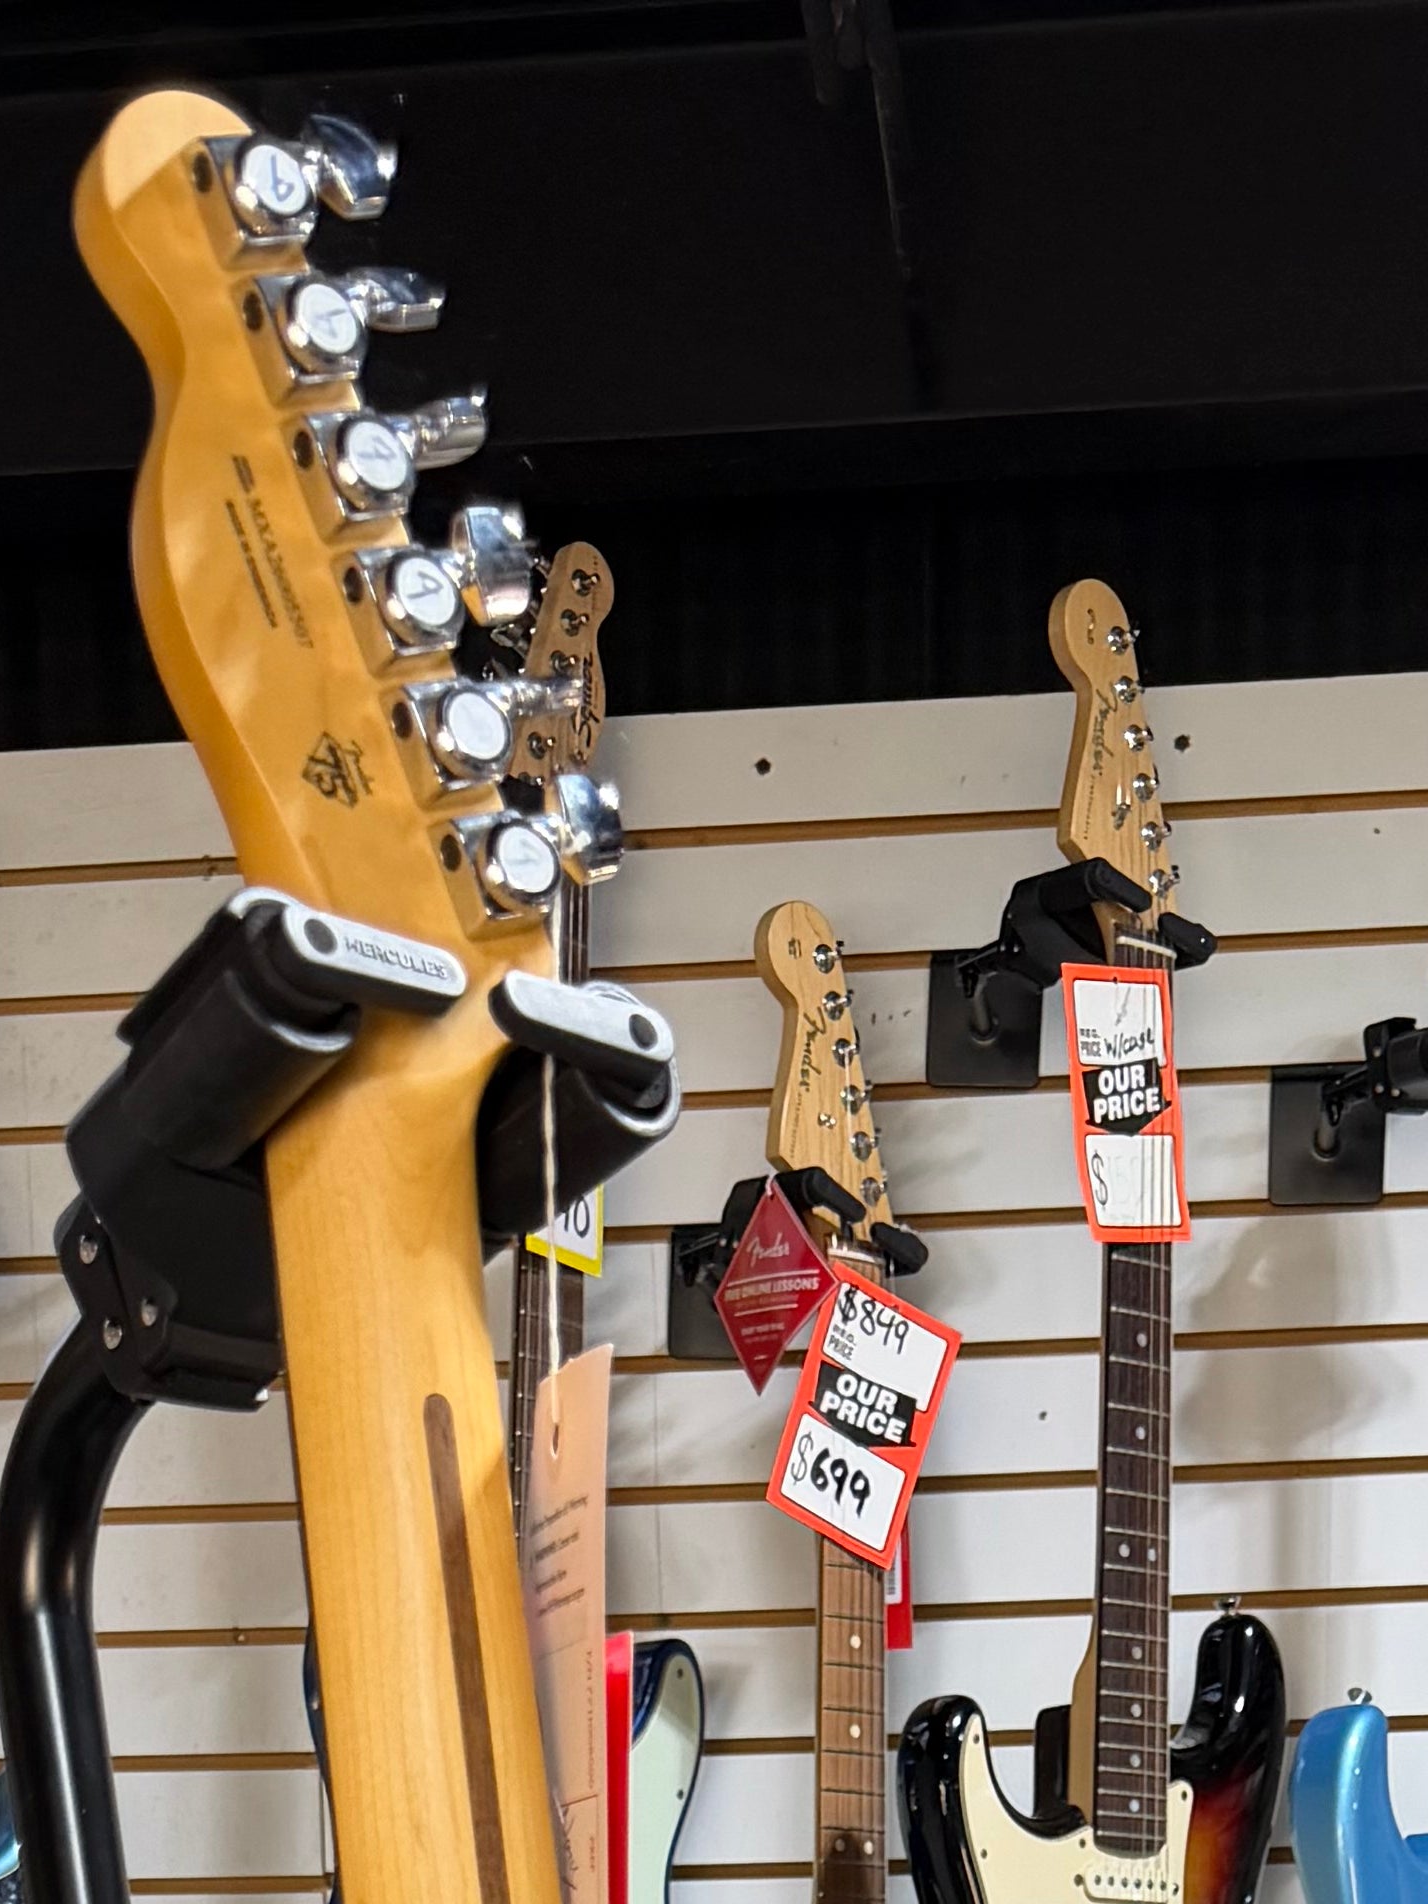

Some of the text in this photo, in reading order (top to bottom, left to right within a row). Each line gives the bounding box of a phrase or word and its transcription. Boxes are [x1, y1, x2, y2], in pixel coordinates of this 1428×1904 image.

[1091, 681, 1119, 776] Fender
[343, 935, 450, 980] HERCULES
[798, 1005, 827, 1094] Fender
[1097, 1064, 1146, 1096] OUR
[1092, 1087, 1162, 1125] PRICE
[772, 1276, 820, 1294] LESSONS
[837, 1283, 910, 1355] $849
[819, 1389, 908, 1445] PRICE
[836, 1372, 899, 1416] OUR
[790, 1430, 872, 1520] $699
